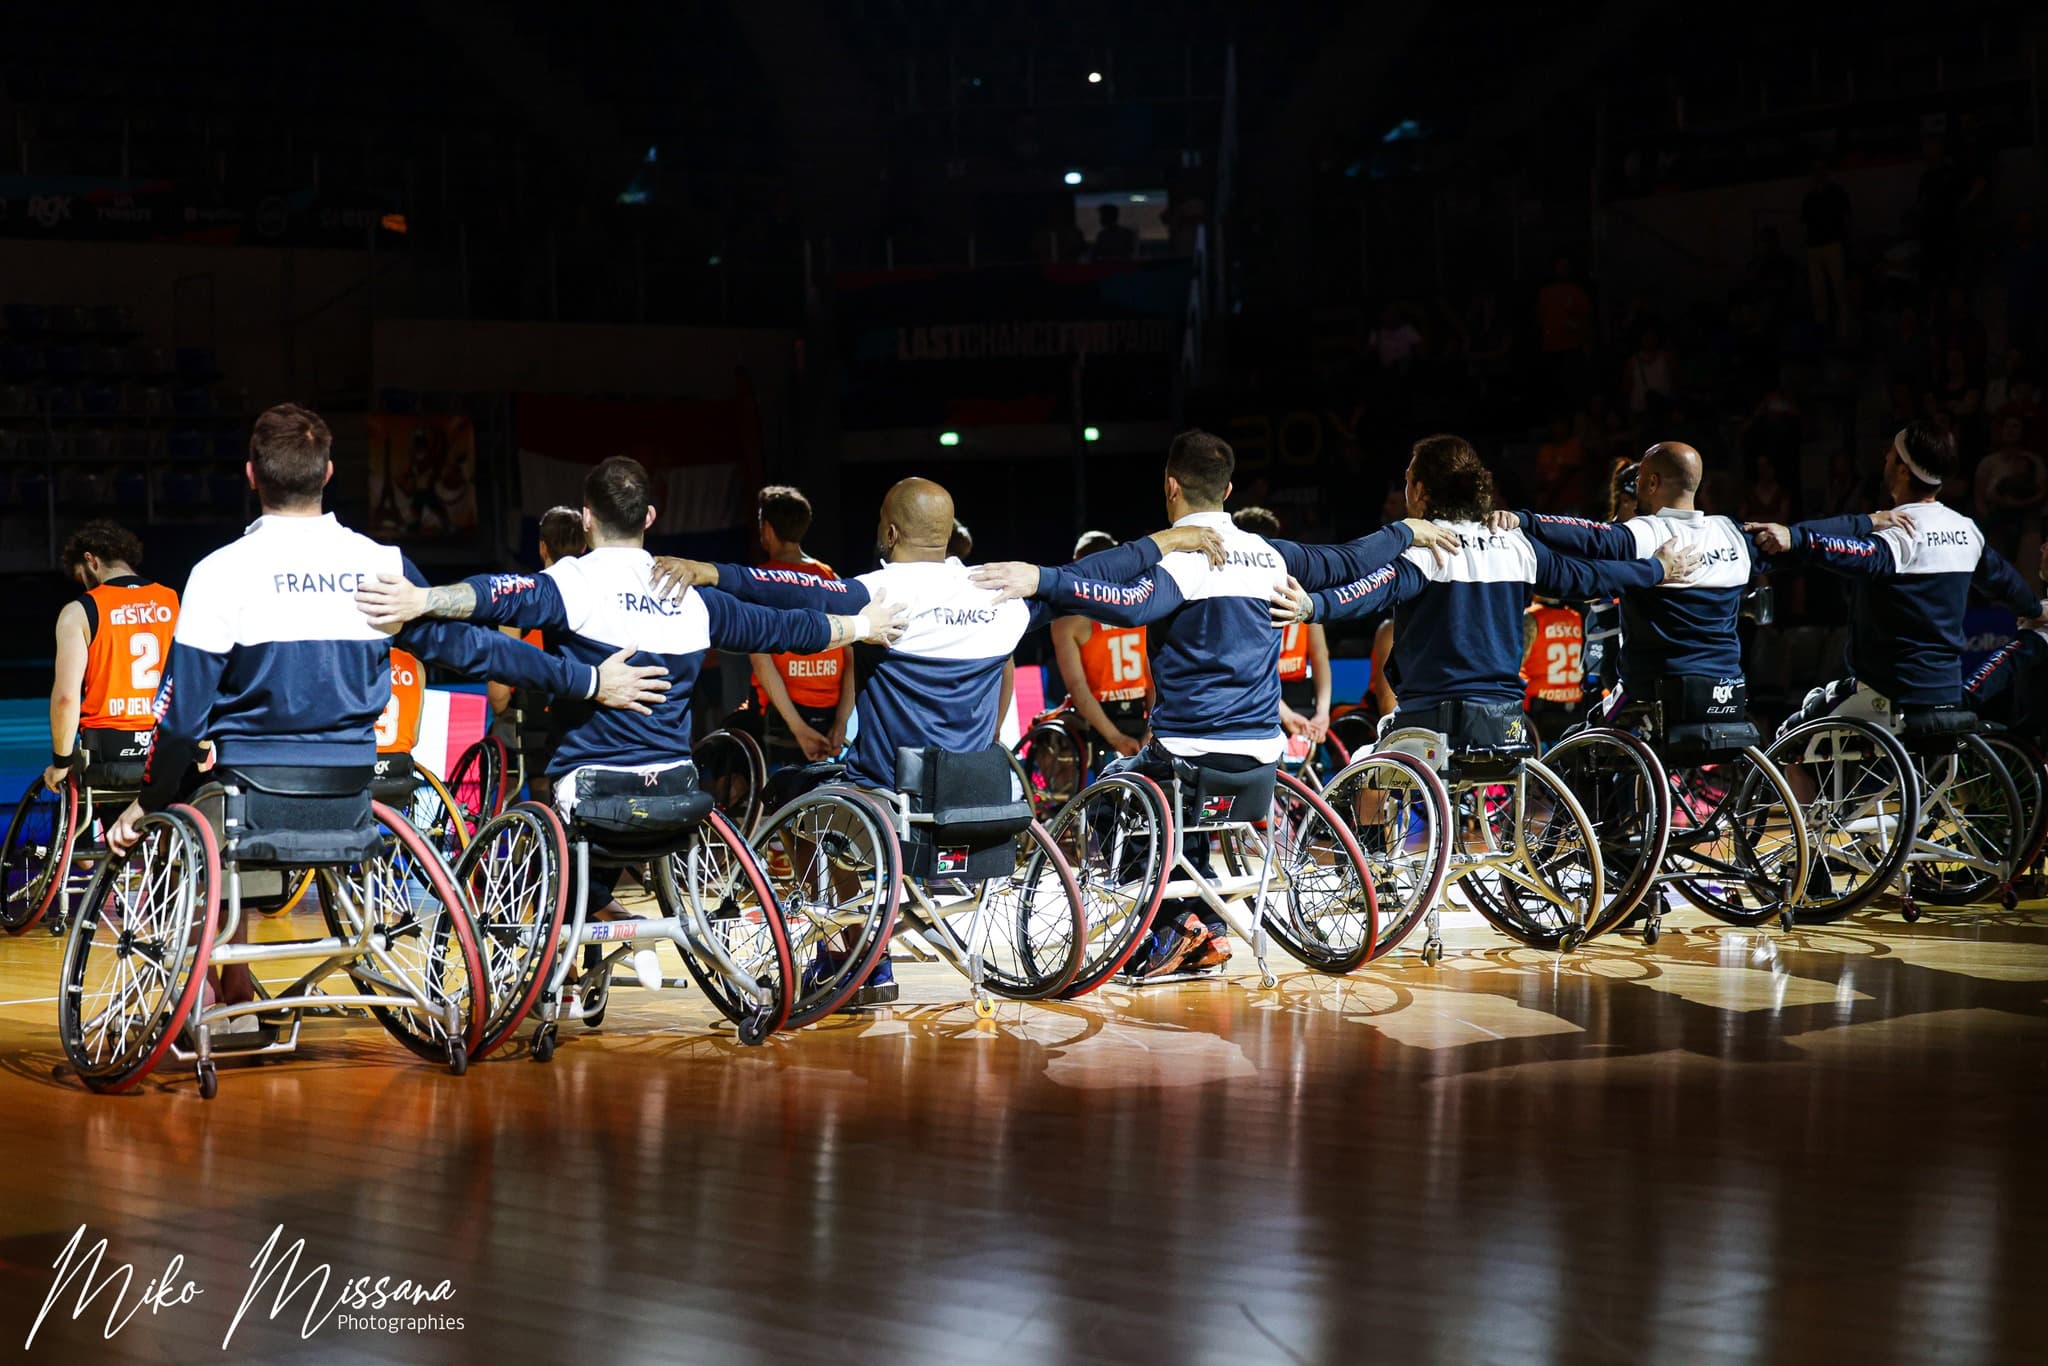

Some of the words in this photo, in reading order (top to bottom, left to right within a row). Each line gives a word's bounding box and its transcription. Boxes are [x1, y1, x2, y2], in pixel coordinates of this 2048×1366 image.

[1455, 533, 1510, 551] RANCE
[1926, 531, 1968, 547] FRANCE
[1224, 549, 1277, 569] RANCE
[1699, 547, 1739, 566] ANCE
[273, 572, 366, 594] FRANCE
[1074, 581, 1091, 600] LE
[1093, 583, 1121, 606] COQ
[129, 632, 161, 690] 2
[788, 659, 838, 677] BELLERS
[1107, 633, 1143, 683] 15
[1546, 642, 1585, 685] 23
[108, 698, 125, 717] OP
[128, 697, 151, 717] DEN
[1706, 705, 1739, 714] ELITE
[119, 747, 149, 757] ELIT
